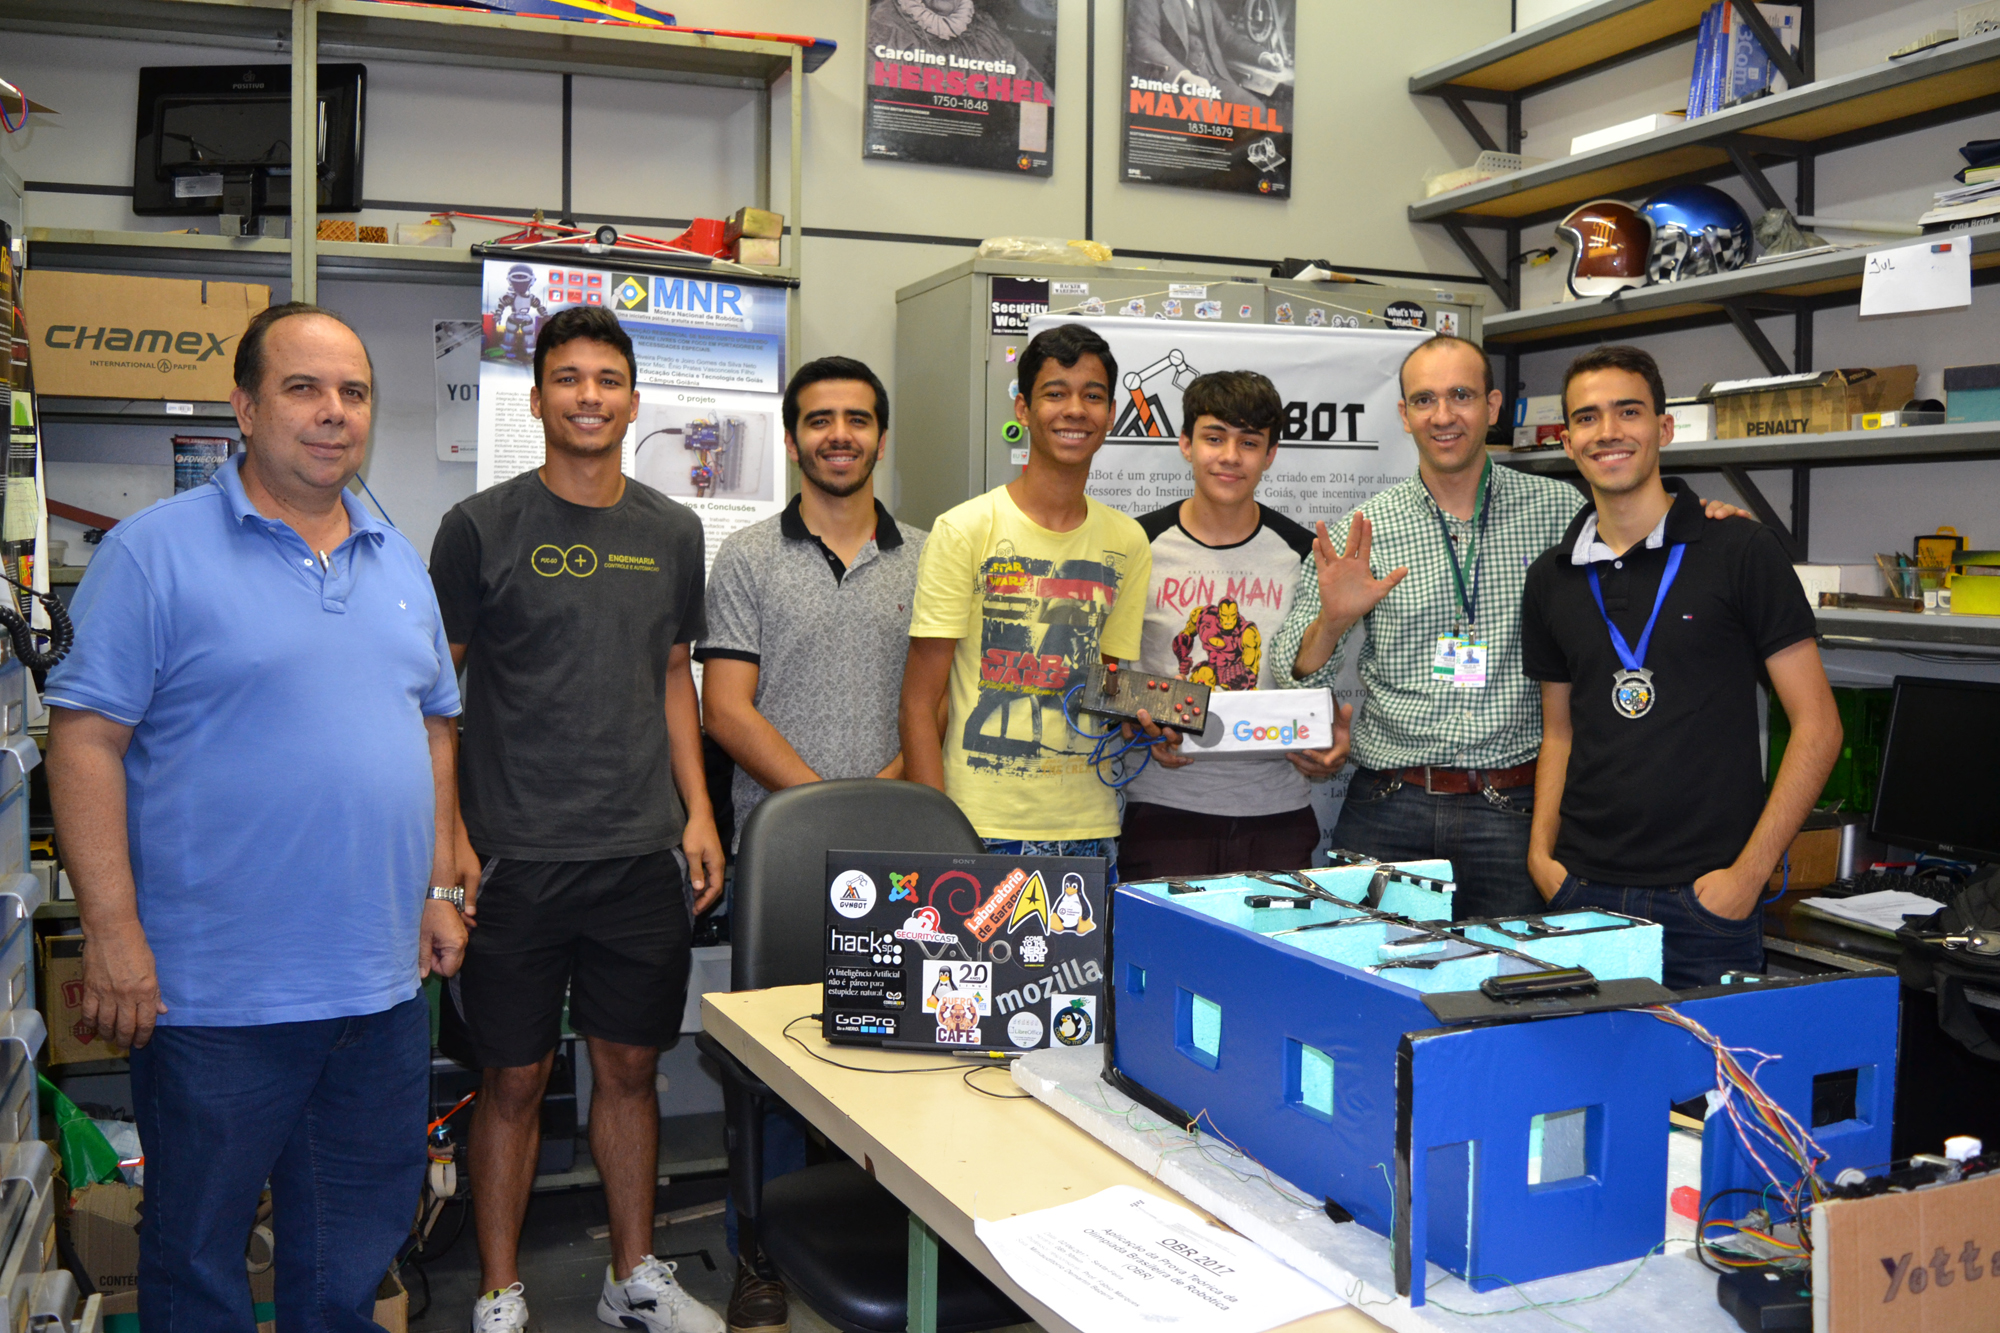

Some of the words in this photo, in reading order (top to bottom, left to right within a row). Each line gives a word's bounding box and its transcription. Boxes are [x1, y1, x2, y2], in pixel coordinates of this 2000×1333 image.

[874, 44, 947, 66] Caroline
[949, 57, 1016, 75] Lucretia
[1735, 24, 1754, 85] 3Com
[874, 61, 1051, 107] HERSCHEL
[1130, 75, 1180, 94] James
[1182, 85, 1222, 100] Clerk
[933, 95, 989, 111] 1750-1848
[1130, 89, 1284, 133] MAXWELL
[1188, 123, 1233, 138] 1831-1879
[654, 277, 743, 316] MNR
[654, 308, 675, 317] Mostra
[677, 311, 704, 319] Nacional
[991, 301, 1048, 315] Security
[1387, 307, 1408, 317] What's
[1410, 309, 1424, 319] Your
[90, 360, 156, 370] INTERNATIONAL
[639, 367, 671, 378] Educação
[671, 370, 694, 378] Ciência
[701, 372, 736, 382] Tecnologia
[745, 376, 764, 384] Goiás
[687, 395, 716, 404] projeto
[1747, 419, 1809, 436] PENALTY
[1117, 470, 1123, 481] é
[1128, 472, 1145, 481] um
[1149, 473, 1181, 484] grupo
[1276, 471, 1307, 483] criado
[1310, 475, 1326, 483] em
[1330, 472, 1355, 484] 2014
[1358, 475, 1374, 486] por
[1136, 486, 1152, 497] do
[1264, 487, 1296, 500] Goiás,
[1300, 491, 1318, 501] que
[1322, 488, 1367, 499] incentiva
[707, 502, 756, 512] Conclusões
[1295, 505, 1302, 513] o
[1308, 503, 1342, 514] intuito
[608, 554, 655, 565] ENGENHARIA
[989, 562, 1025, 574] STAR
[989, 576, 1028, 587] WARS
[1156, 574, 1215, 616] IRON
[1226, 576, 1283, 611] MAN
[981, 648, 1069, 673] STAR
[982, 663, 1070, 689] WARS
[1233, 719, 1310, 746] Google
[840, 901, 868, 909] GYNBOT
[967, 871, 1024, 931] Laboratório
[896, 931, 957, 943] SECURITYCAST
[978, 924, 993, 940] de
[831, 929, 883, 954] hack
[1019, 946, 1049, 956] NERD
[1023, 955, 1046, 963] SIDE
[836, 969, 873, 979] Inteligência
[873, 970, 901, 979] Artificial
[959, 963, 989, 985] 20
[842, 978, 847, 986] é
[849, 979, 869, 990] páreo
[870, 981, 885, 990] para
[995, 958, 1104, 1016] mozilla
[828, 988, 859, 998] estupidez
[942, 996, 973, 1007] QUERO
[1015, 1028, 1043, 1036] LibreOffice
[1161, 1238, 1198, 1257] OBR
[1194, 1255, 1236, 1275] 2017
[1083, 1228, 1128, 1254] Olimpíada
[1126, 1252, 1171, 1279] Brasileira
[1170, 1277, 1184, 1286] de
[1183, 1284, 1230, 1311] Robótica
[1101, 1228, 1146, 1253] Aplicação
[1145, 1250, 1159, 1260] da
[1157, 1258, 1188, 1275] Prova
[1188, 1274, 1224, 1295] Teórica
[1223, 1294, 1238, 1303] da
[1121, 1263, 1155, 1280] (OBR)
